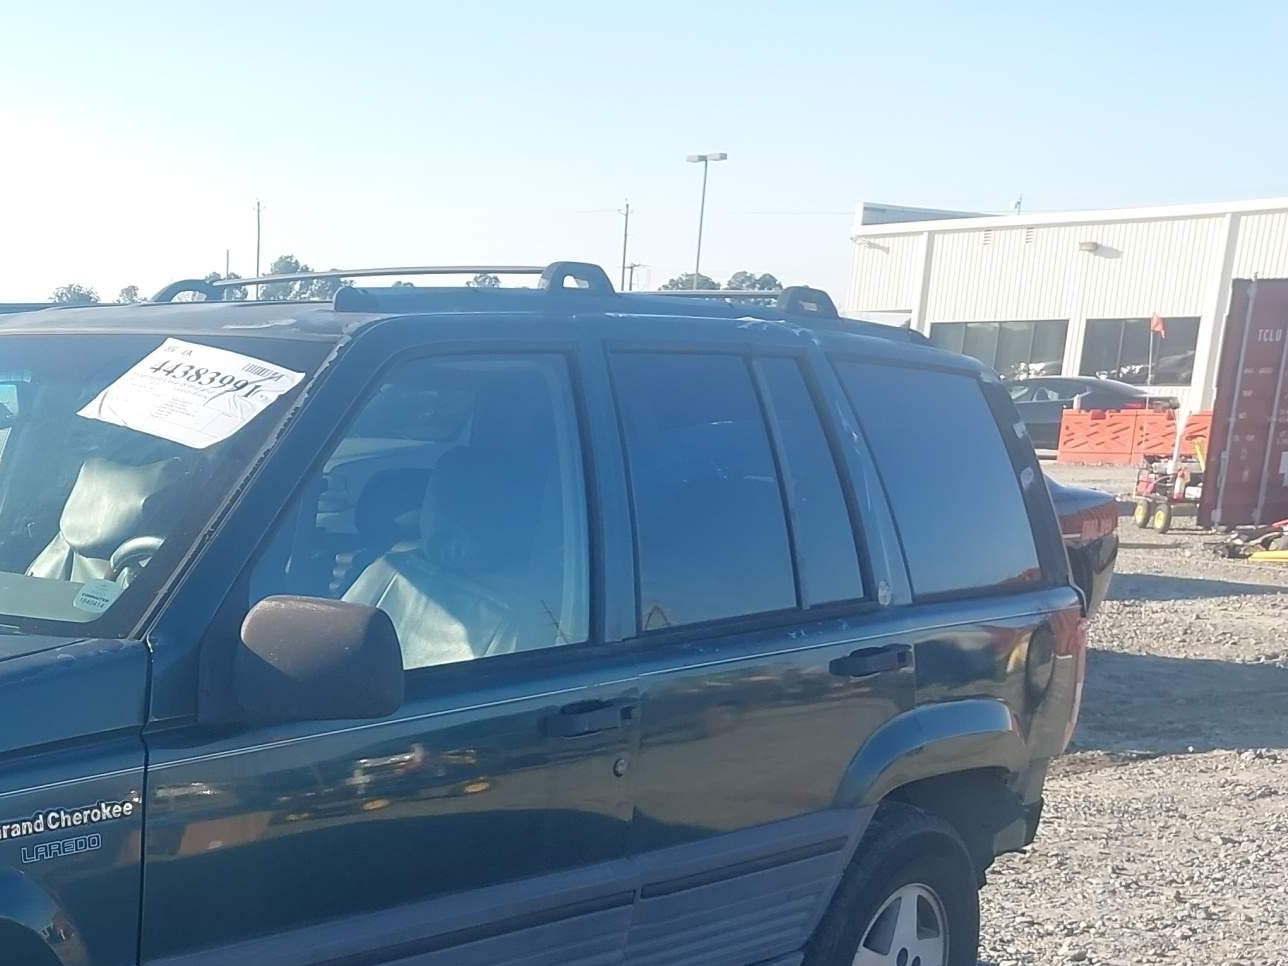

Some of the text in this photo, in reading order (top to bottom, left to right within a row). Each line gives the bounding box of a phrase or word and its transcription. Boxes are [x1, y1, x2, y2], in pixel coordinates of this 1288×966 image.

[150, 360, 261, 399] 44383991
[47, 802, 134, 830] Cherokee
[22, 834, 102, 864] LAREDO
